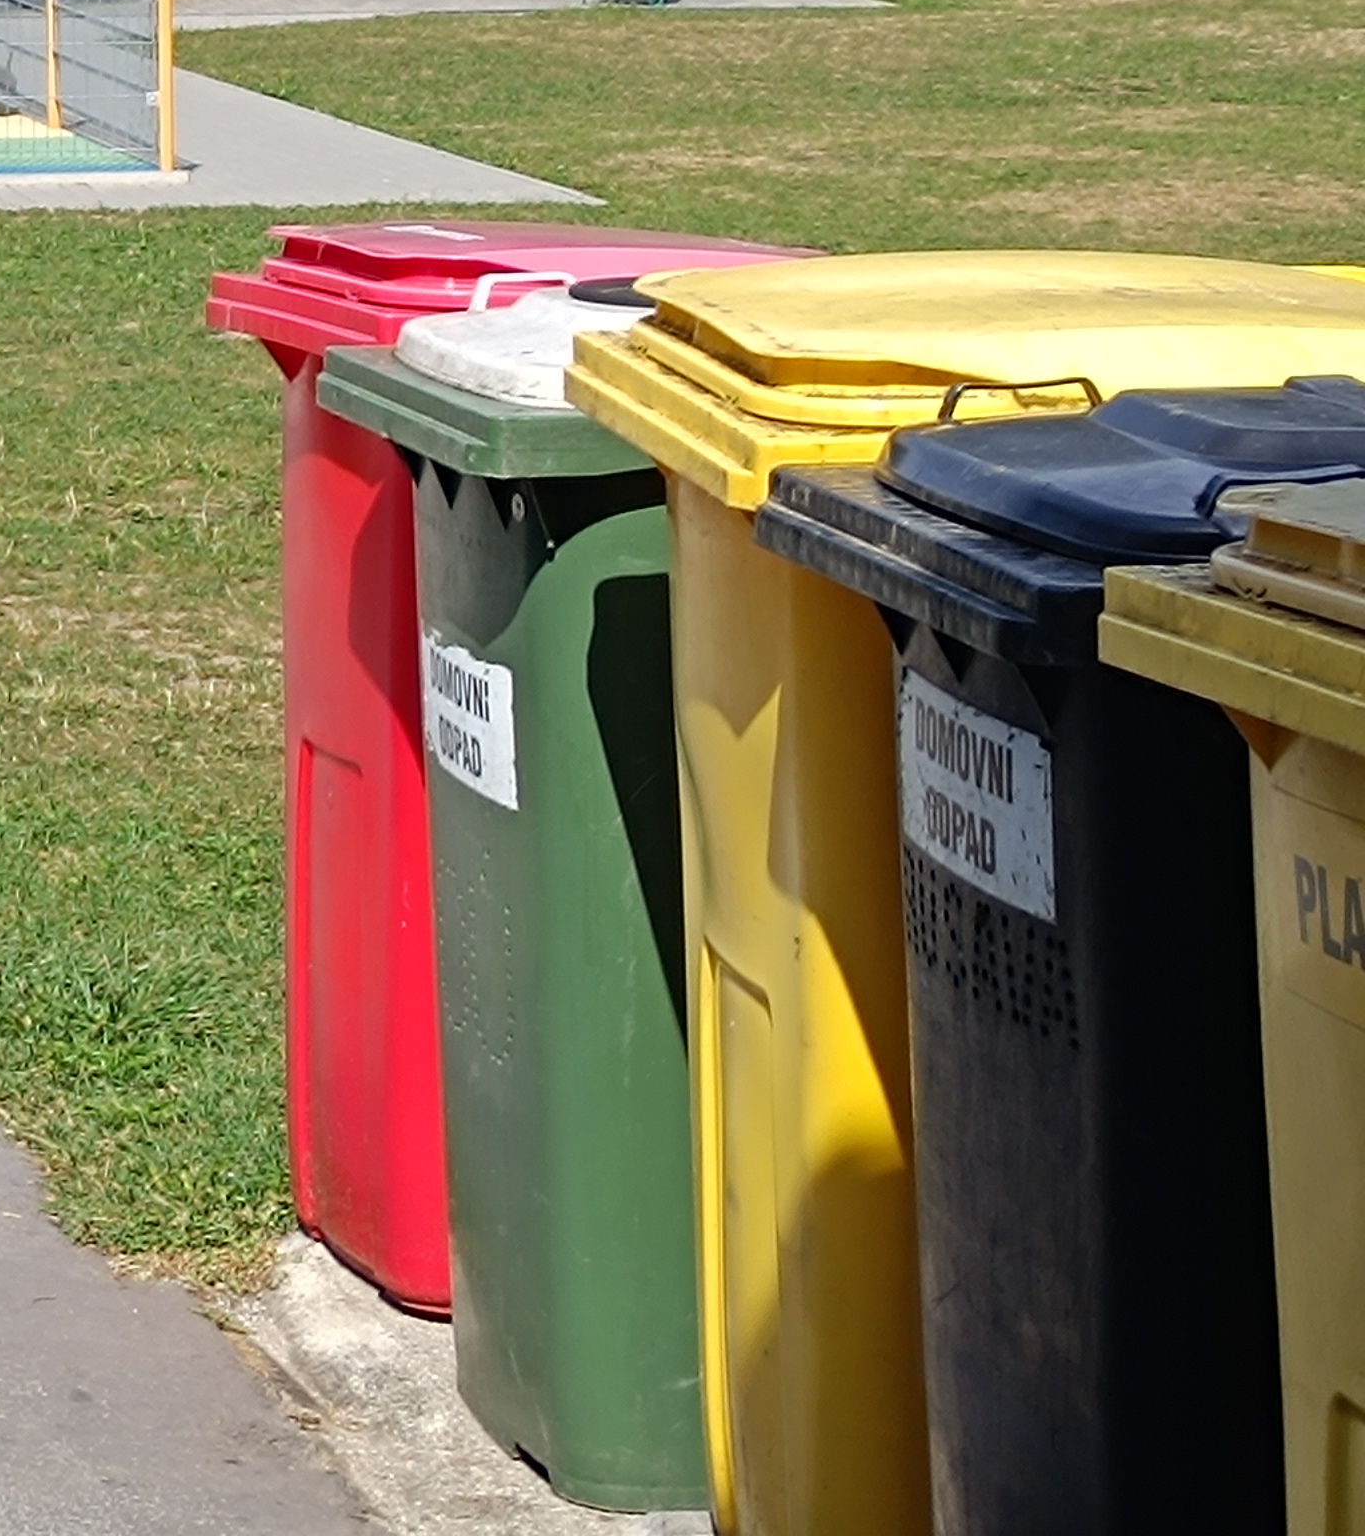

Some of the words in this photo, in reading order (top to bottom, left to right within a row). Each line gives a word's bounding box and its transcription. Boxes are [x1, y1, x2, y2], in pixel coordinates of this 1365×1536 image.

[430, 647, 490, 723] DOMOVNÍ
[438, 714, 482, 779] ODPAD
[915, 694, 1015, 804] DOMOVNÍ
[925, 786, 997, 875] ODPAD
